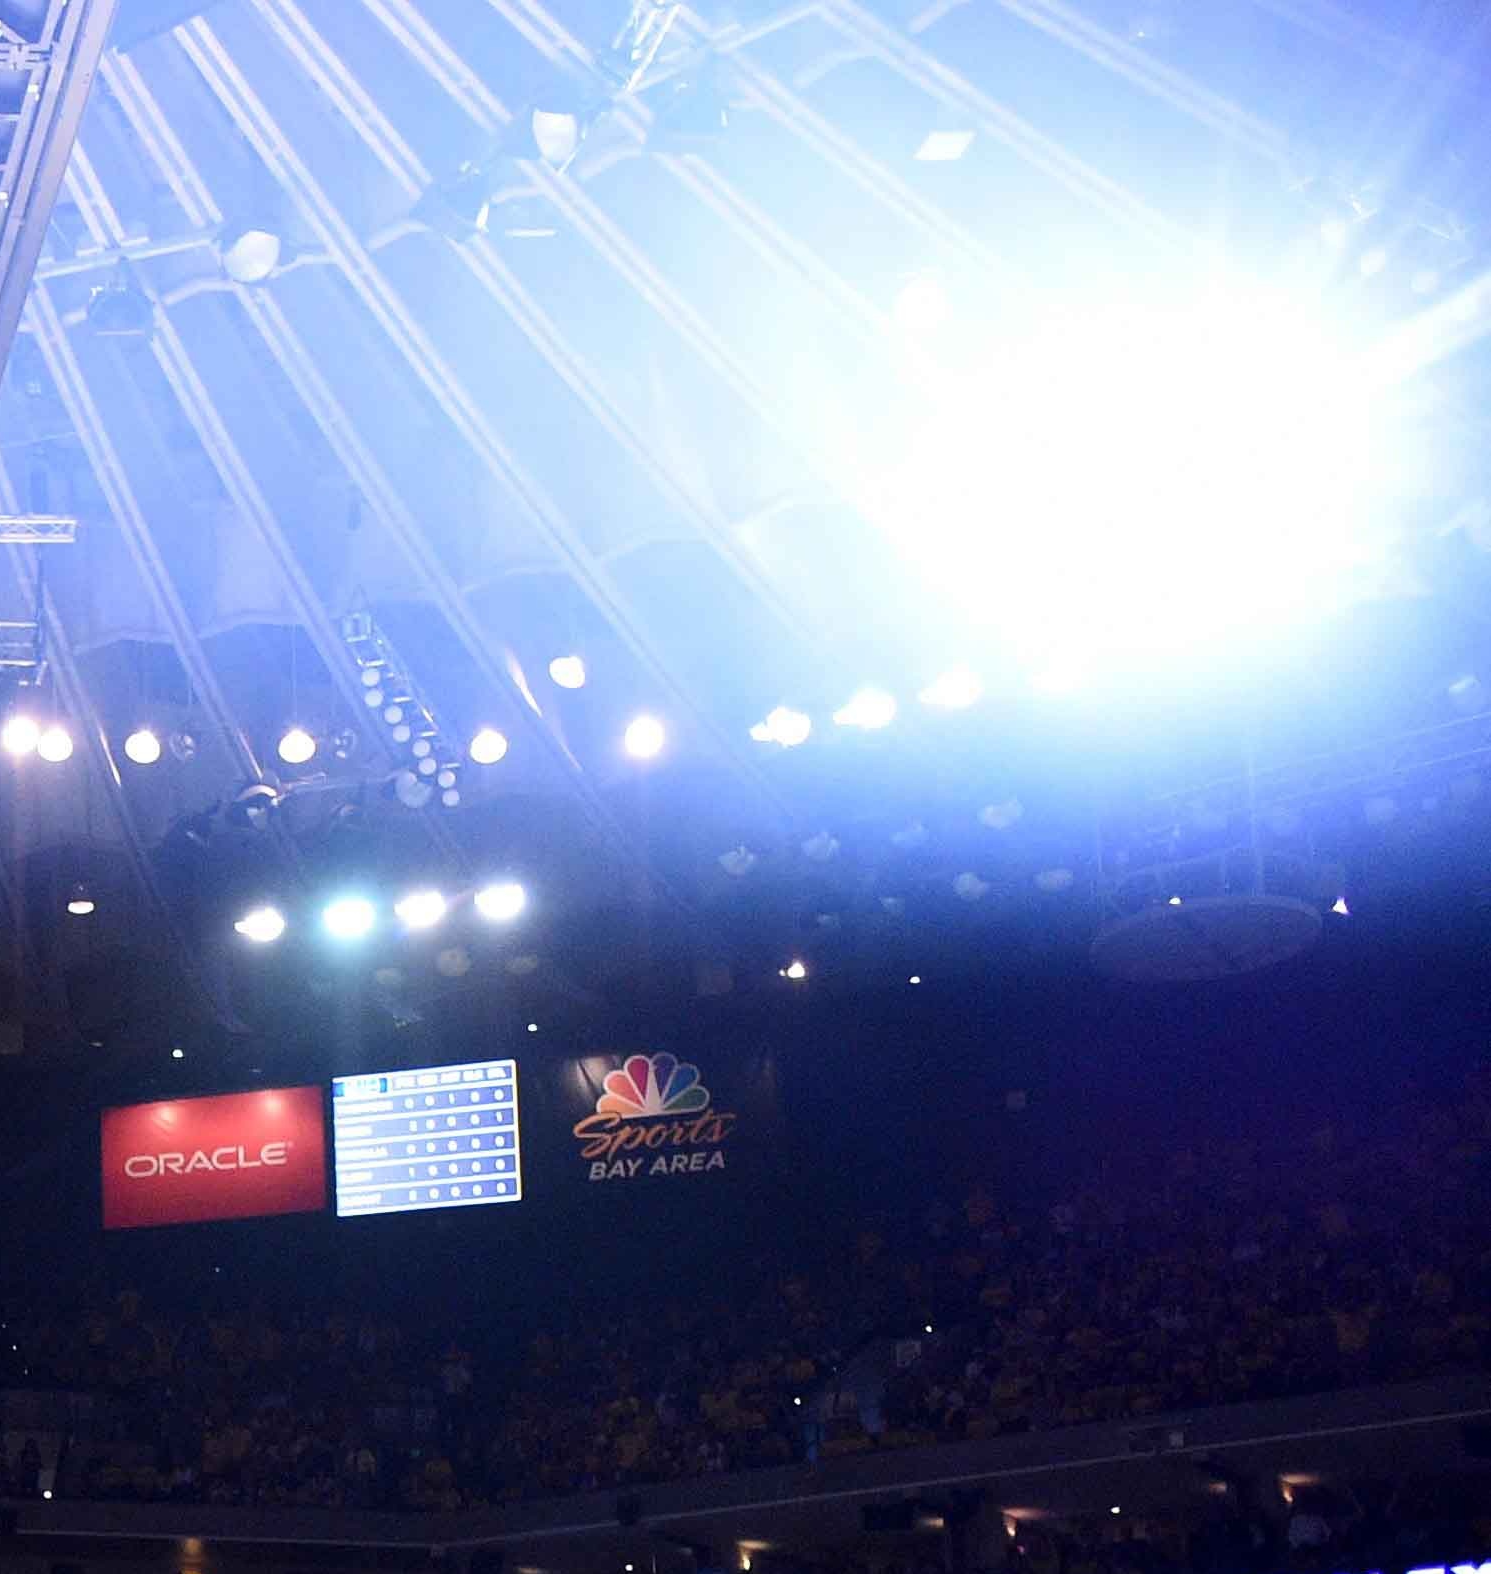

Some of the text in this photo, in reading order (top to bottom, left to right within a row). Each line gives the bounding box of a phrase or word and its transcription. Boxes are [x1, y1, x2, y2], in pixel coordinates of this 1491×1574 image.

[573, 1107, 737, 1163] Sports
[124, 1142, 290, 1179] ORACLE
[588, 1148, 727, 1182] BAY AREA
